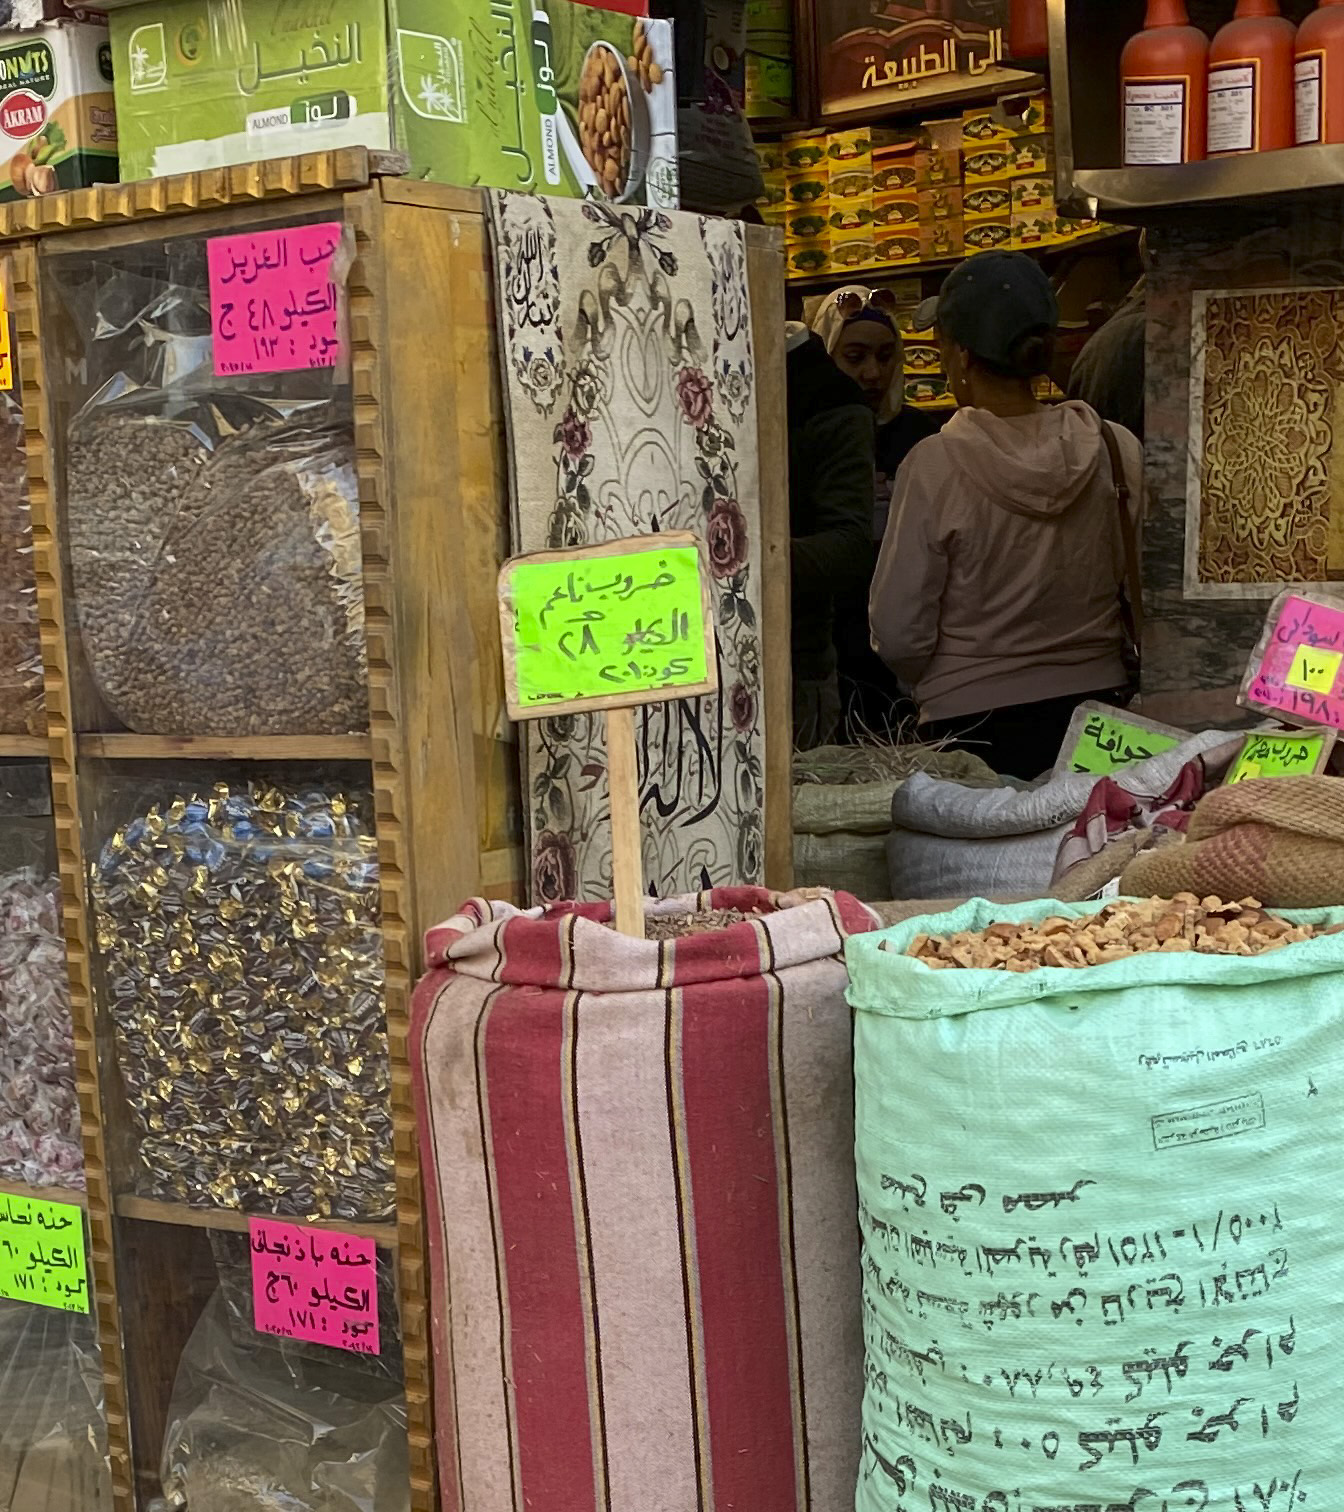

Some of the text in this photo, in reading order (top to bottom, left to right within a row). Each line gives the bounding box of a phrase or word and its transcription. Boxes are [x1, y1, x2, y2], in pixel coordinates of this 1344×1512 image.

[236, 24, 363, 97] النخيل
[860, 38, 958, 92] الطبيعة
[2, 102, 45, 131] AKRAM
[251, 111, 289, 132] ALMOND
[299, 94, 339, 128] لوز
[545, 117, 557, 178] ALMOND
[219, 242, 289, 286] العزيز
[587, 559, 677, 601] خروب
[879, 1172, 927, 1212] صنع
[1001, 1178, 1097, 1214] مصر
[36, 1205, 73, 1231] حنه
[25, 1239, 78, 1271] الكيلو
[329, 1243, 372, 1268] حنه
[307, 1272, 372, 1312] الكيلو
[1207, 1315, 1299, 1374] جرام
[1077, 1408, 1171, 1474] كيلو
[1183, 1380, 1301, 1446] جرام
